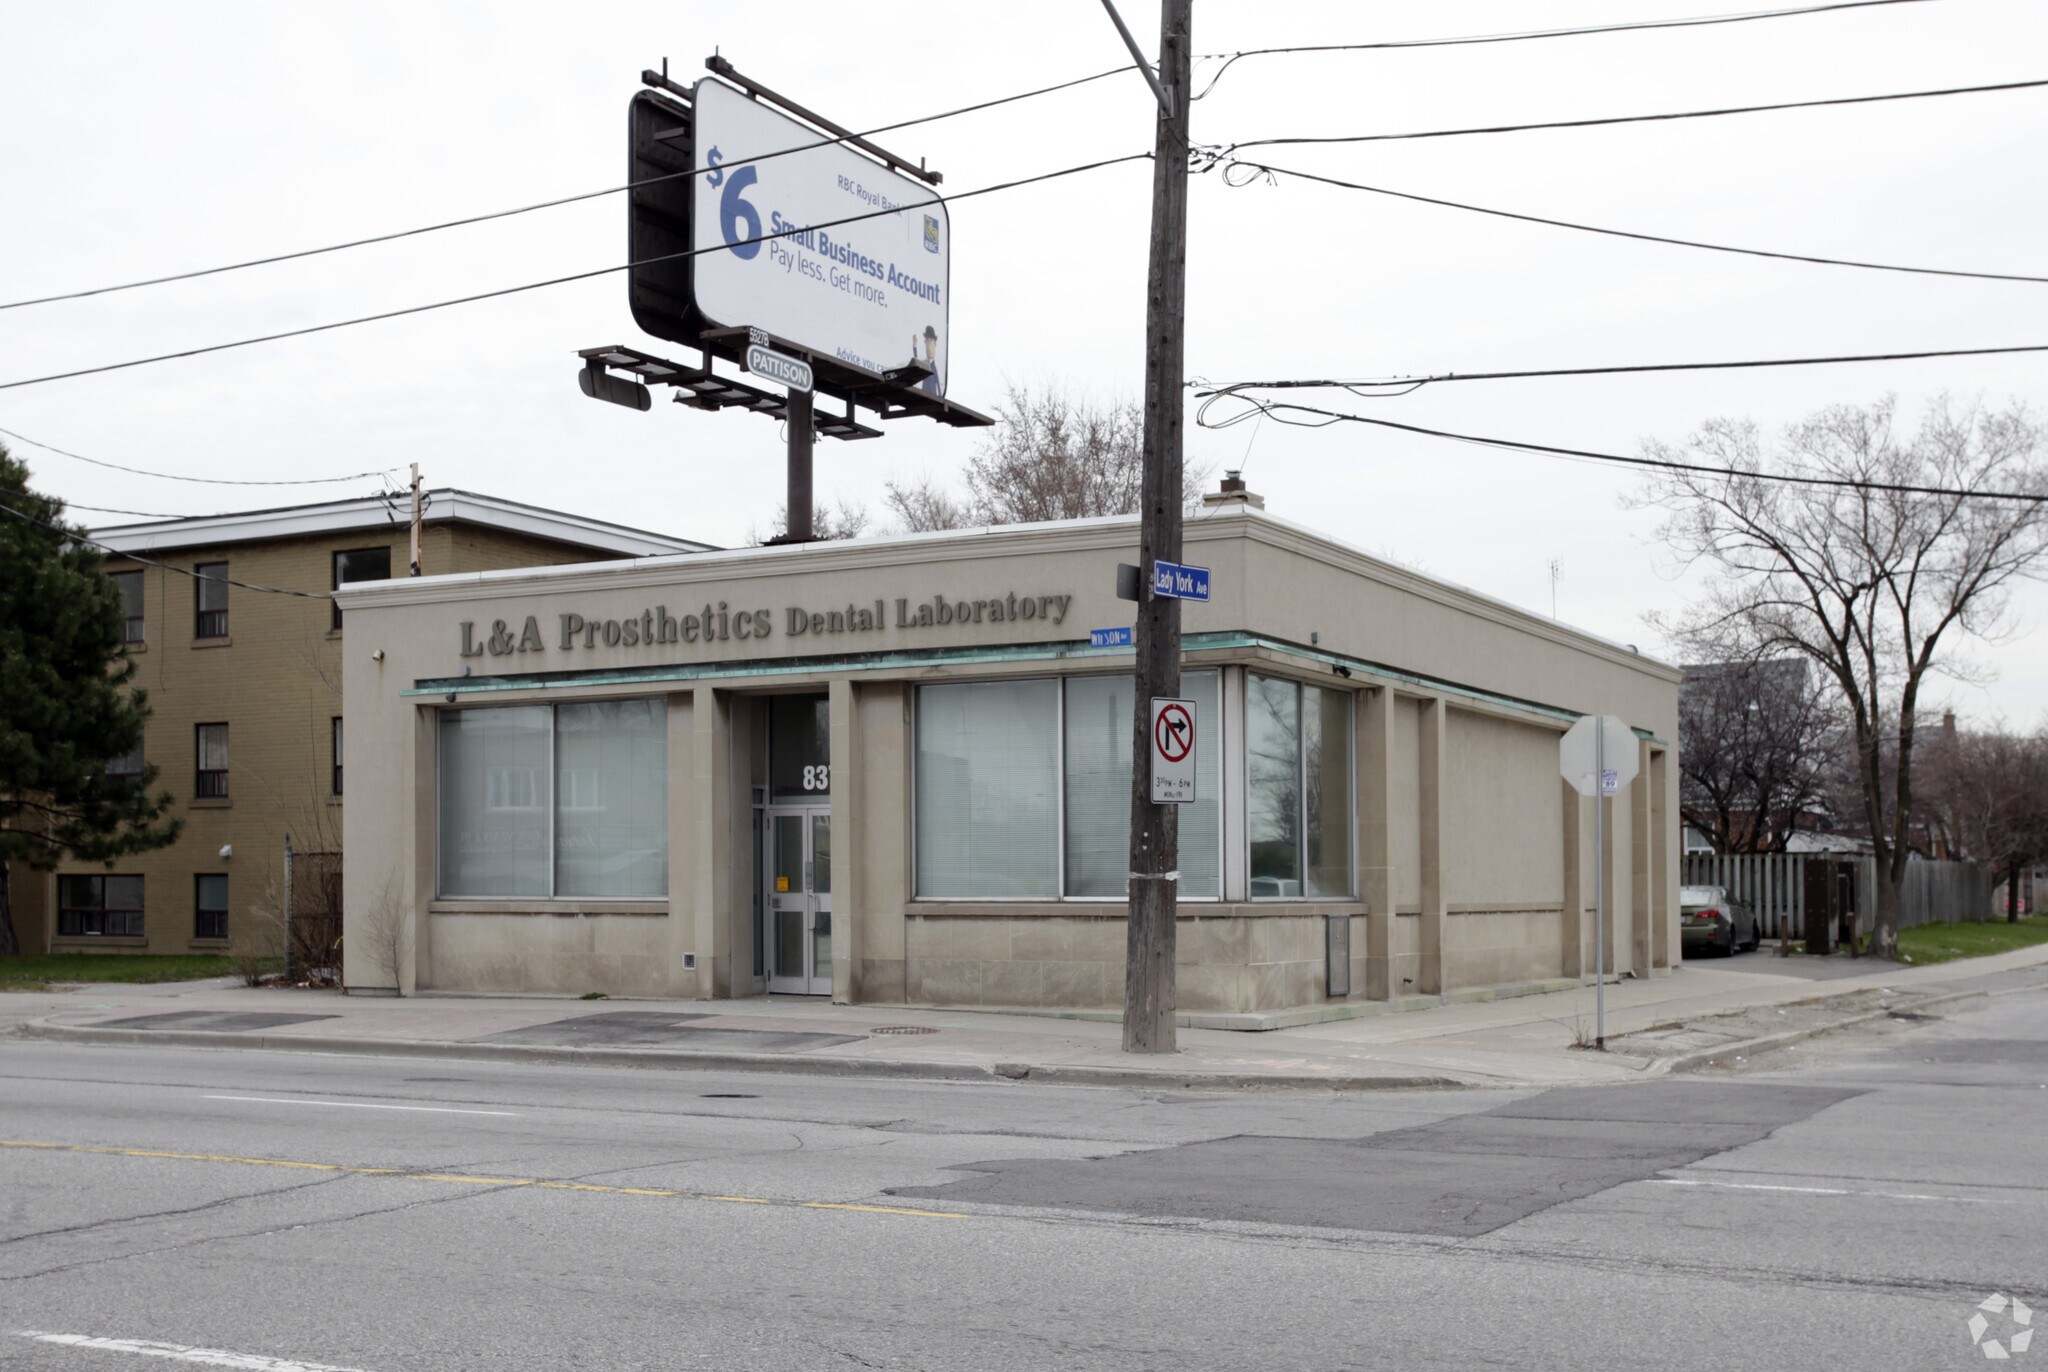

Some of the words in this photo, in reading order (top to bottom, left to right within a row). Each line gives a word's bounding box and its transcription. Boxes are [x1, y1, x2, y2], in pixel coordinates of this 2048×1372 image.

[838, 174, 855, 195] RBC
[857, 184, 880, 206] Royal
[770, 240, 794, 273] Pay
[798, 250, 826, 283] less.
[830, 266, 851, 294] Get
[854, 280, 888, 307] more.
[771, 210, 815, 252] Small
[819, 231, 884, 280] Business
[887, 263, 940, 305] Account
[753, 351, 808, 386] PATTISON
[837, 346, 860, 366] Advice
[1156, 567, 1174, 593] Lady
[1176, 572, 1194, 593] York
[1196, 581, 1207, 595] Ave
[460, 615, 544, 657] L&A
[559, 601, 772, 650] Prosthetics
[785, 599, 884, 636] Dental
[895, 590, 1072, 629] Laboratory
